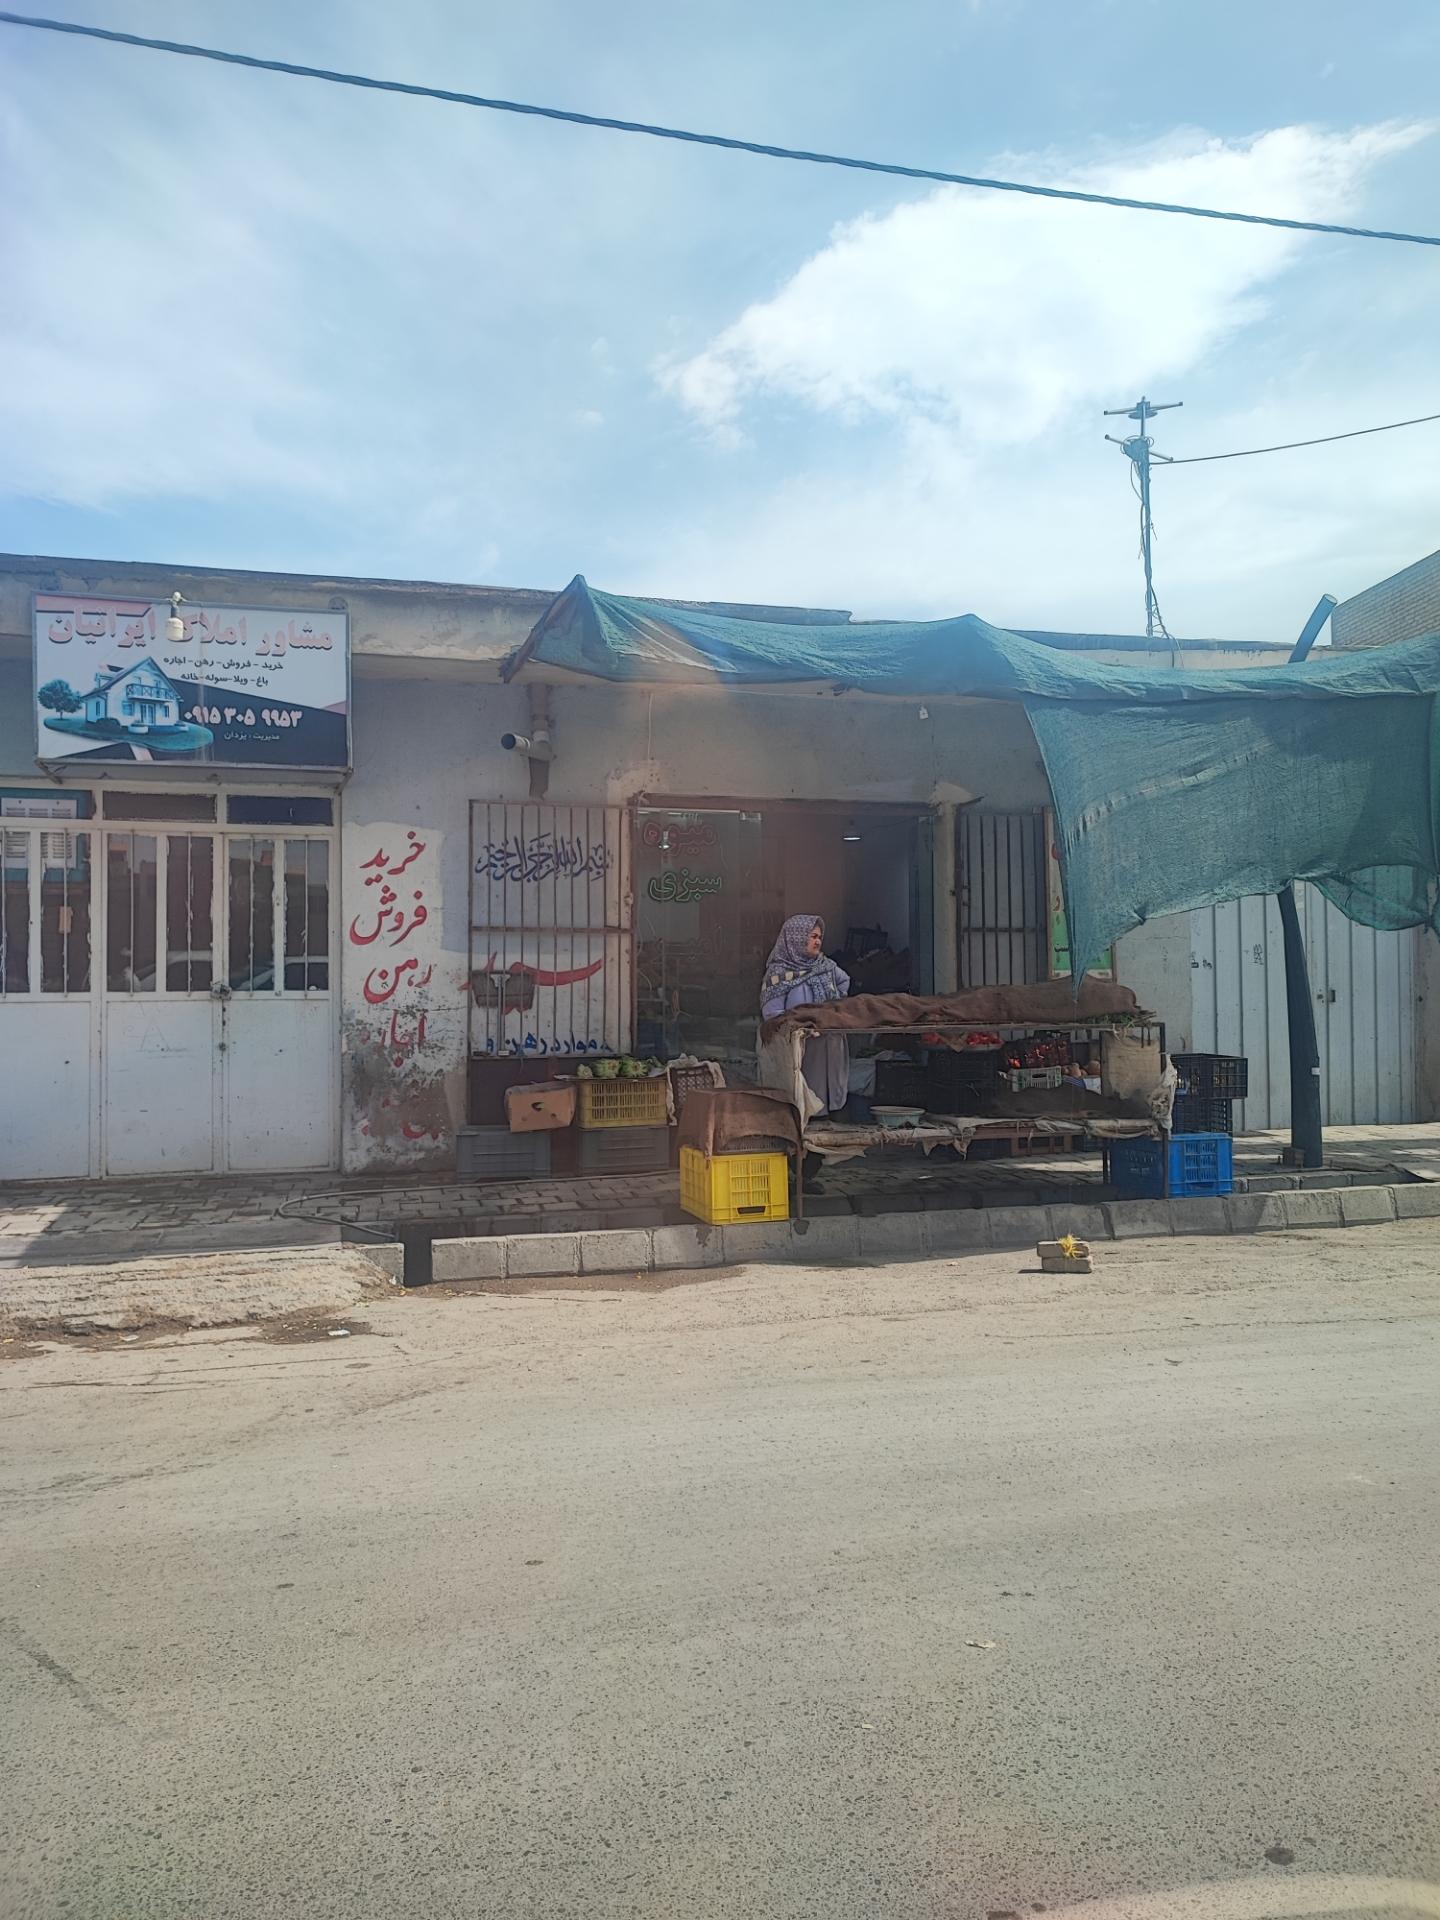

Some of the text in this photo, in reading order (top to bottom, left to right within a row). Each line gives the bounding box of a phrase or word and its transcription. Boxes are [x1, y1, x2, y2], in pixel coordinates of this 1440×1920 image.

[49, 606, 157, 648] ایرانیان
[255, 620, 333, 656] مشاور
[163, 656, 284, 671] خرید فروش رهن اجاره
[180, 672, 269, 688] باغ ویلا سوله خانه
[184, 705, 303, 728] ۰۹۱۵ ۳۰۵ ۹۹۵۳
[223, 730, 247, 741] یزدان
[359, 831, 427, 887] خرید
[648, 868, 722, 902] سبزی
[349, 884, 428, 948] فروش
[363, 957, 432, 1005] رهن
